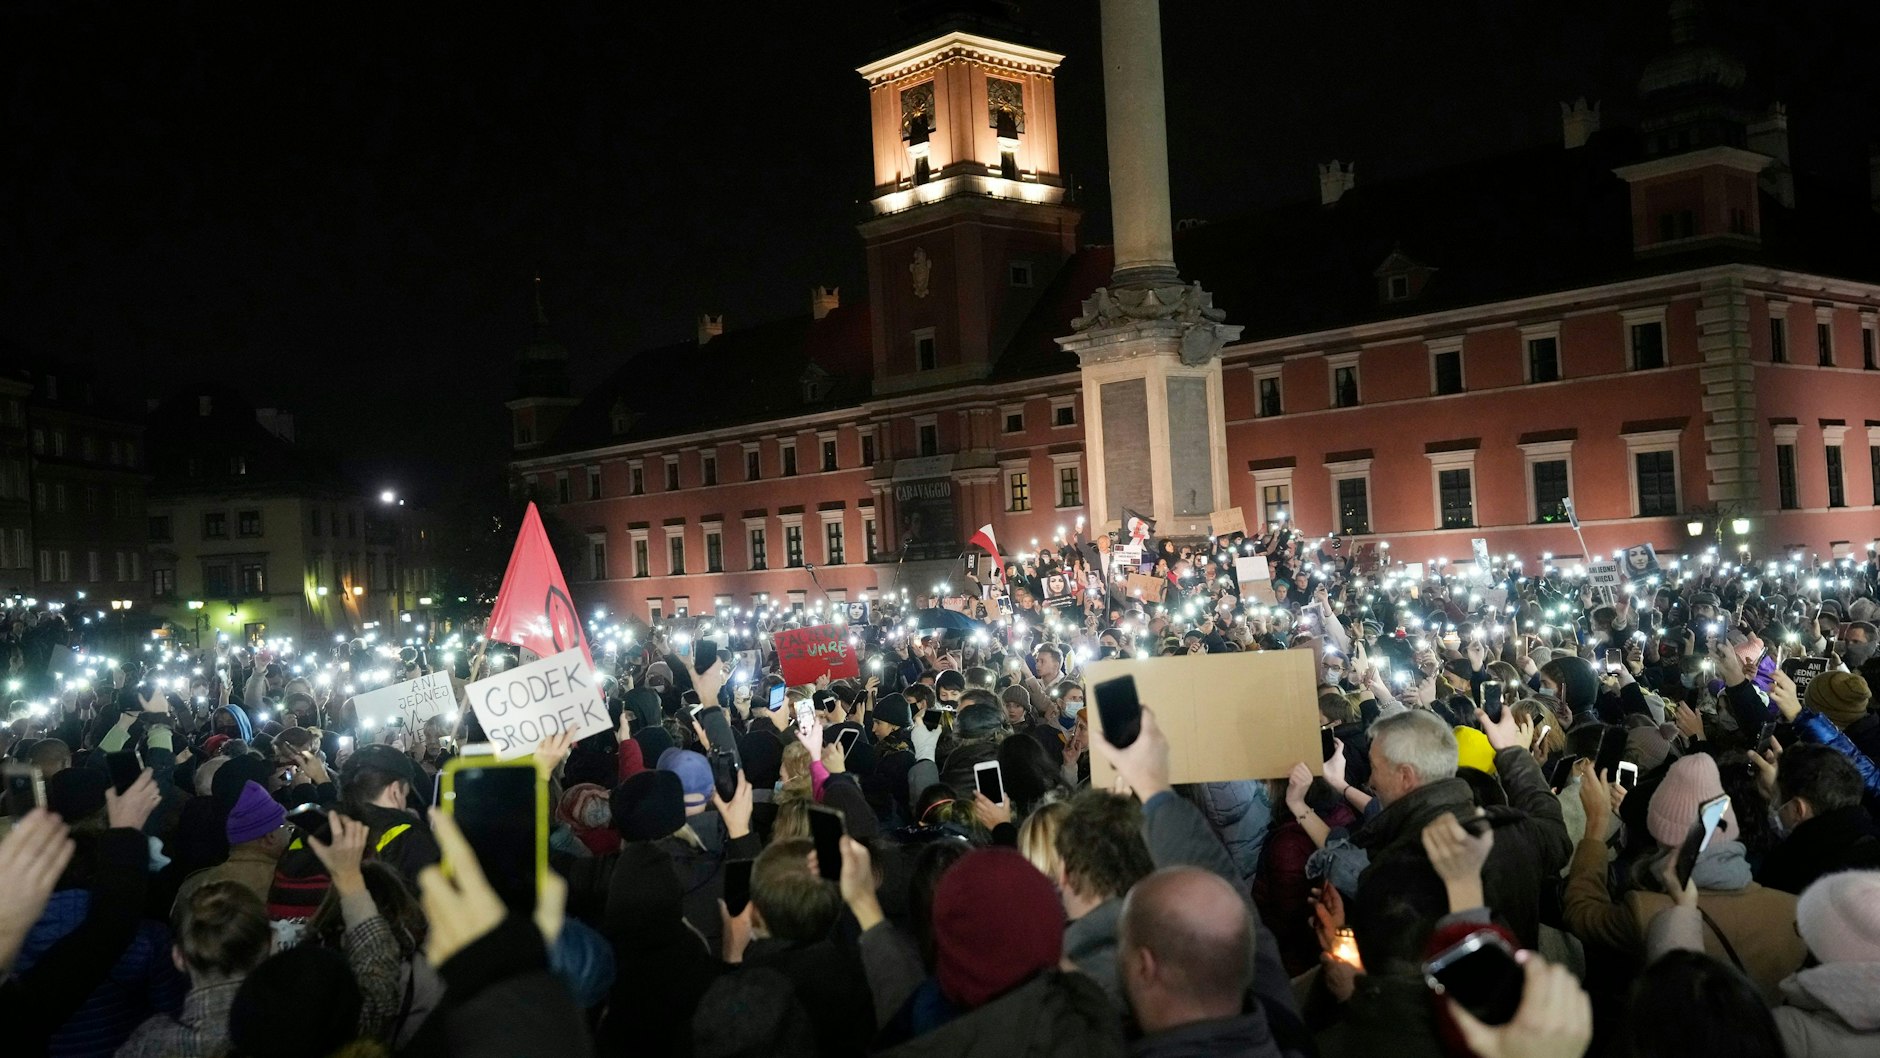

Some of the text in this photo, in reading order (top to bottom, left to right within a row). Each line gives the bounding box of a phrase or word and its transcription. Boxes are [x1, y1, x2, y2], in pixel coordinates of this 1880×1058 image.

[896, 482, 951, 502] CARAVAGGIO
[411, 674, 437, 693] ANI
[485, 662, 587, 717] GODEK
[397, 685, 450, 709] JEDNEJ
[489, 699, 604, 752] SRODEK
